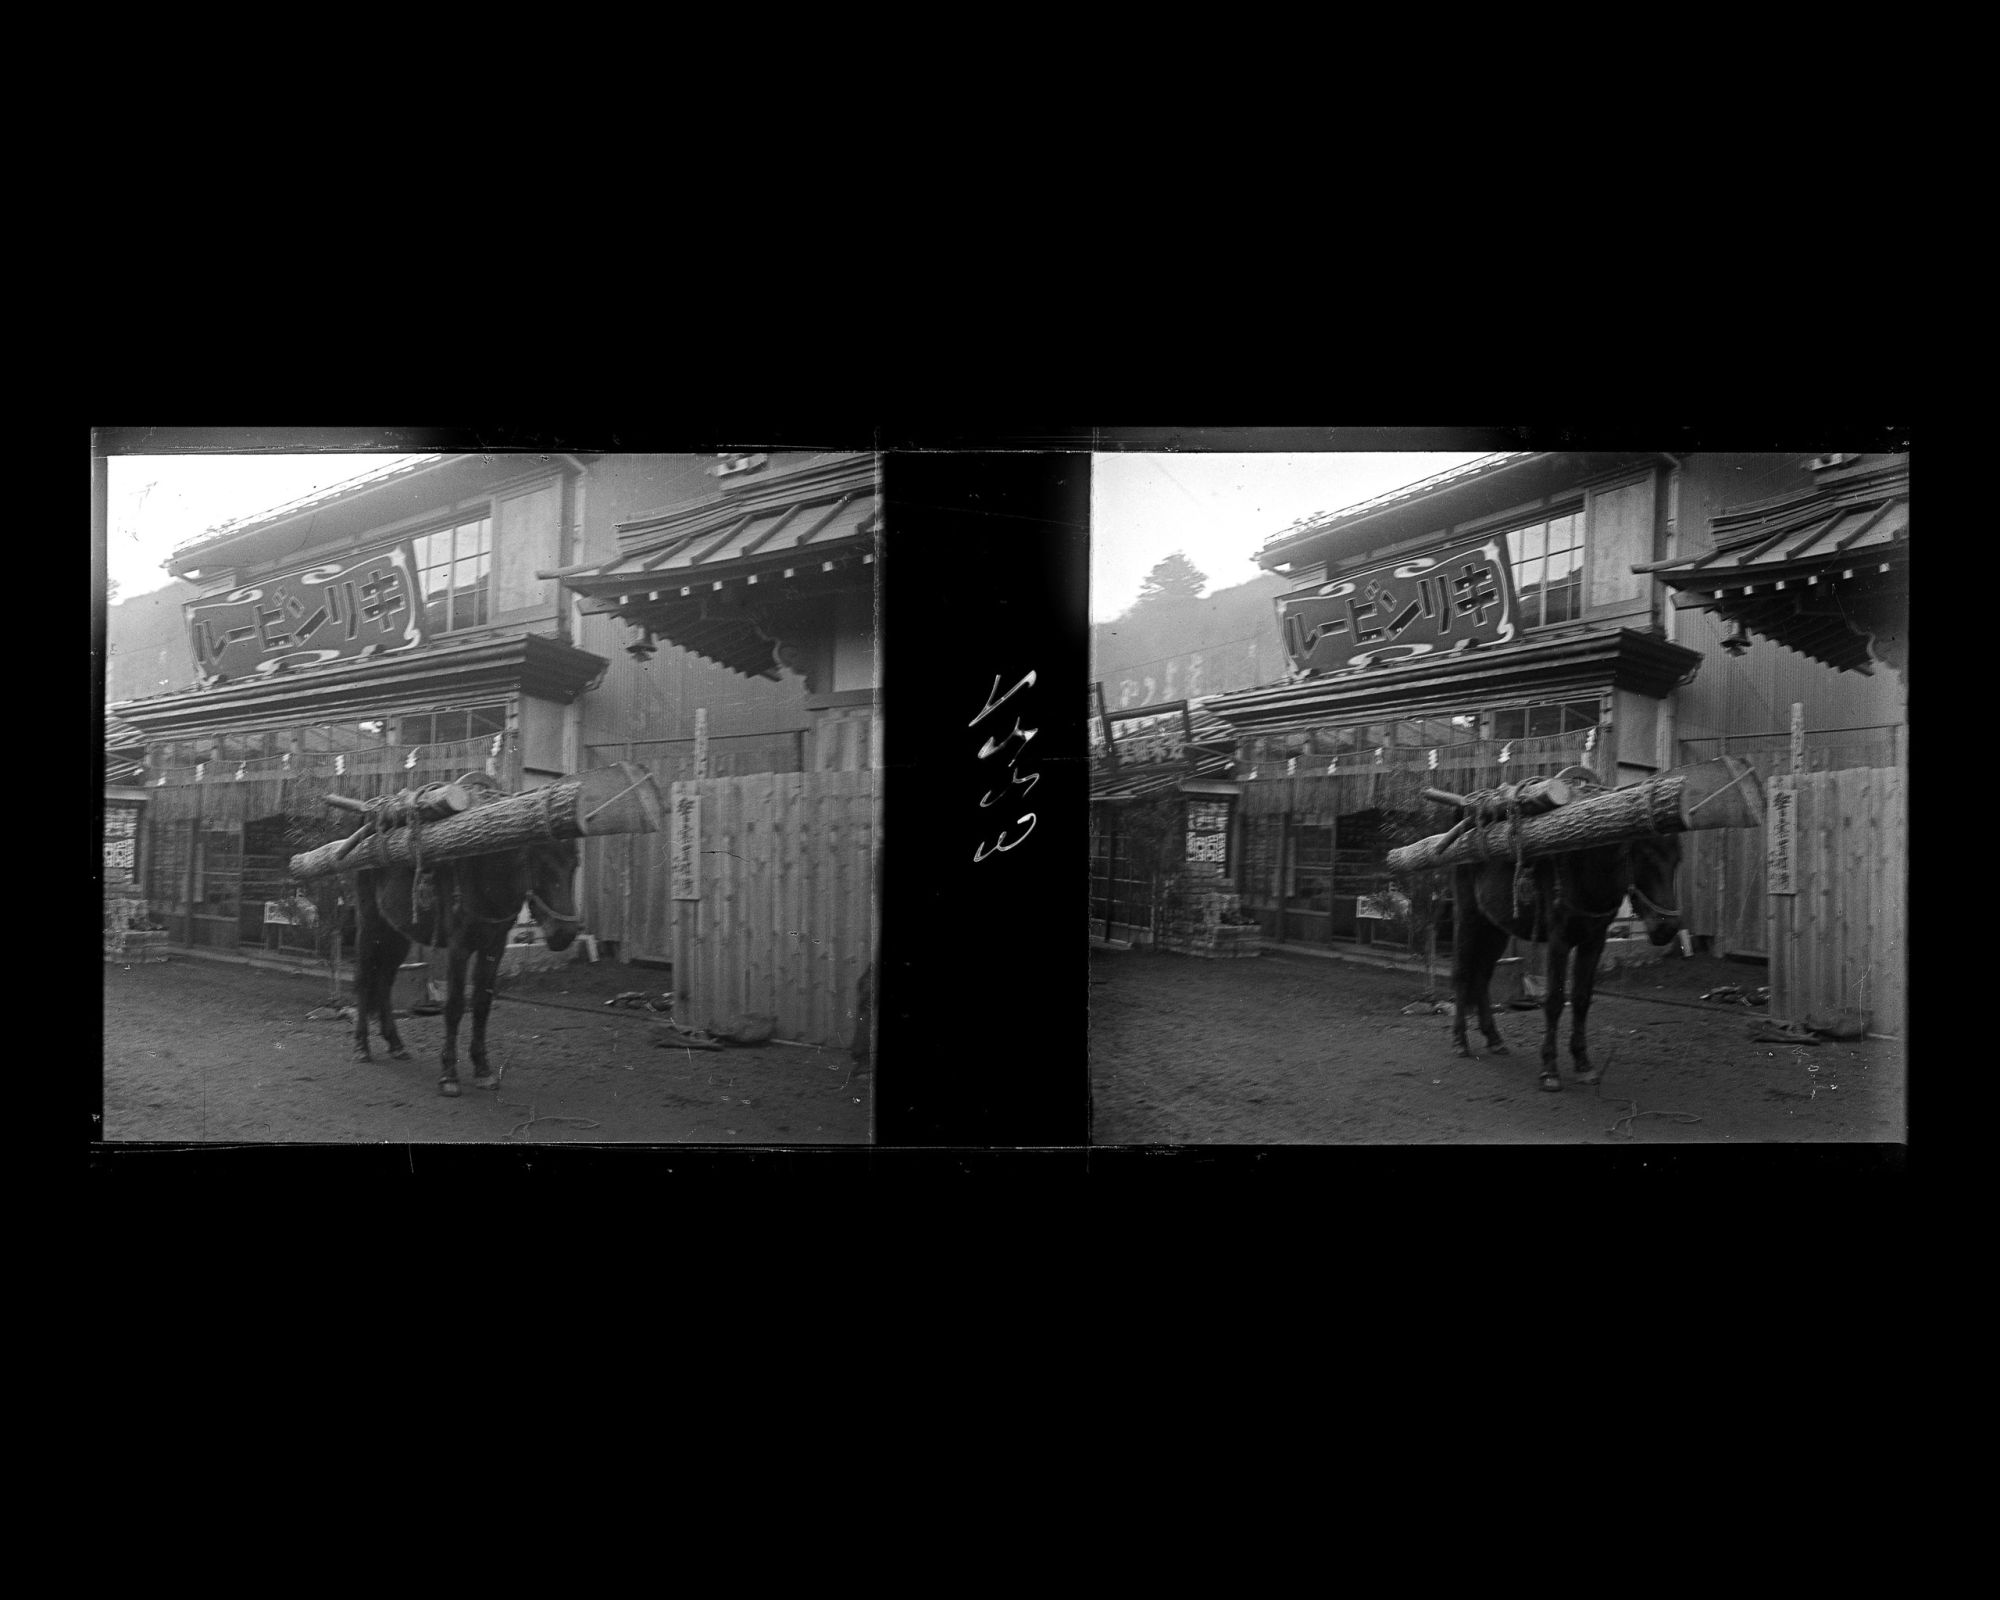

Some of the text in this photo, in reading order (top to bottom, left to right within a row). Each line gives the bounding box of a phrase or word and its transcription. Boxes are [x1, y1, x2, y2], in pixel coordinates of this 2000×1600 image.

[194, 568, 406, 666] キリンビール
[1284, 562, 1500, 660] キリンビール
